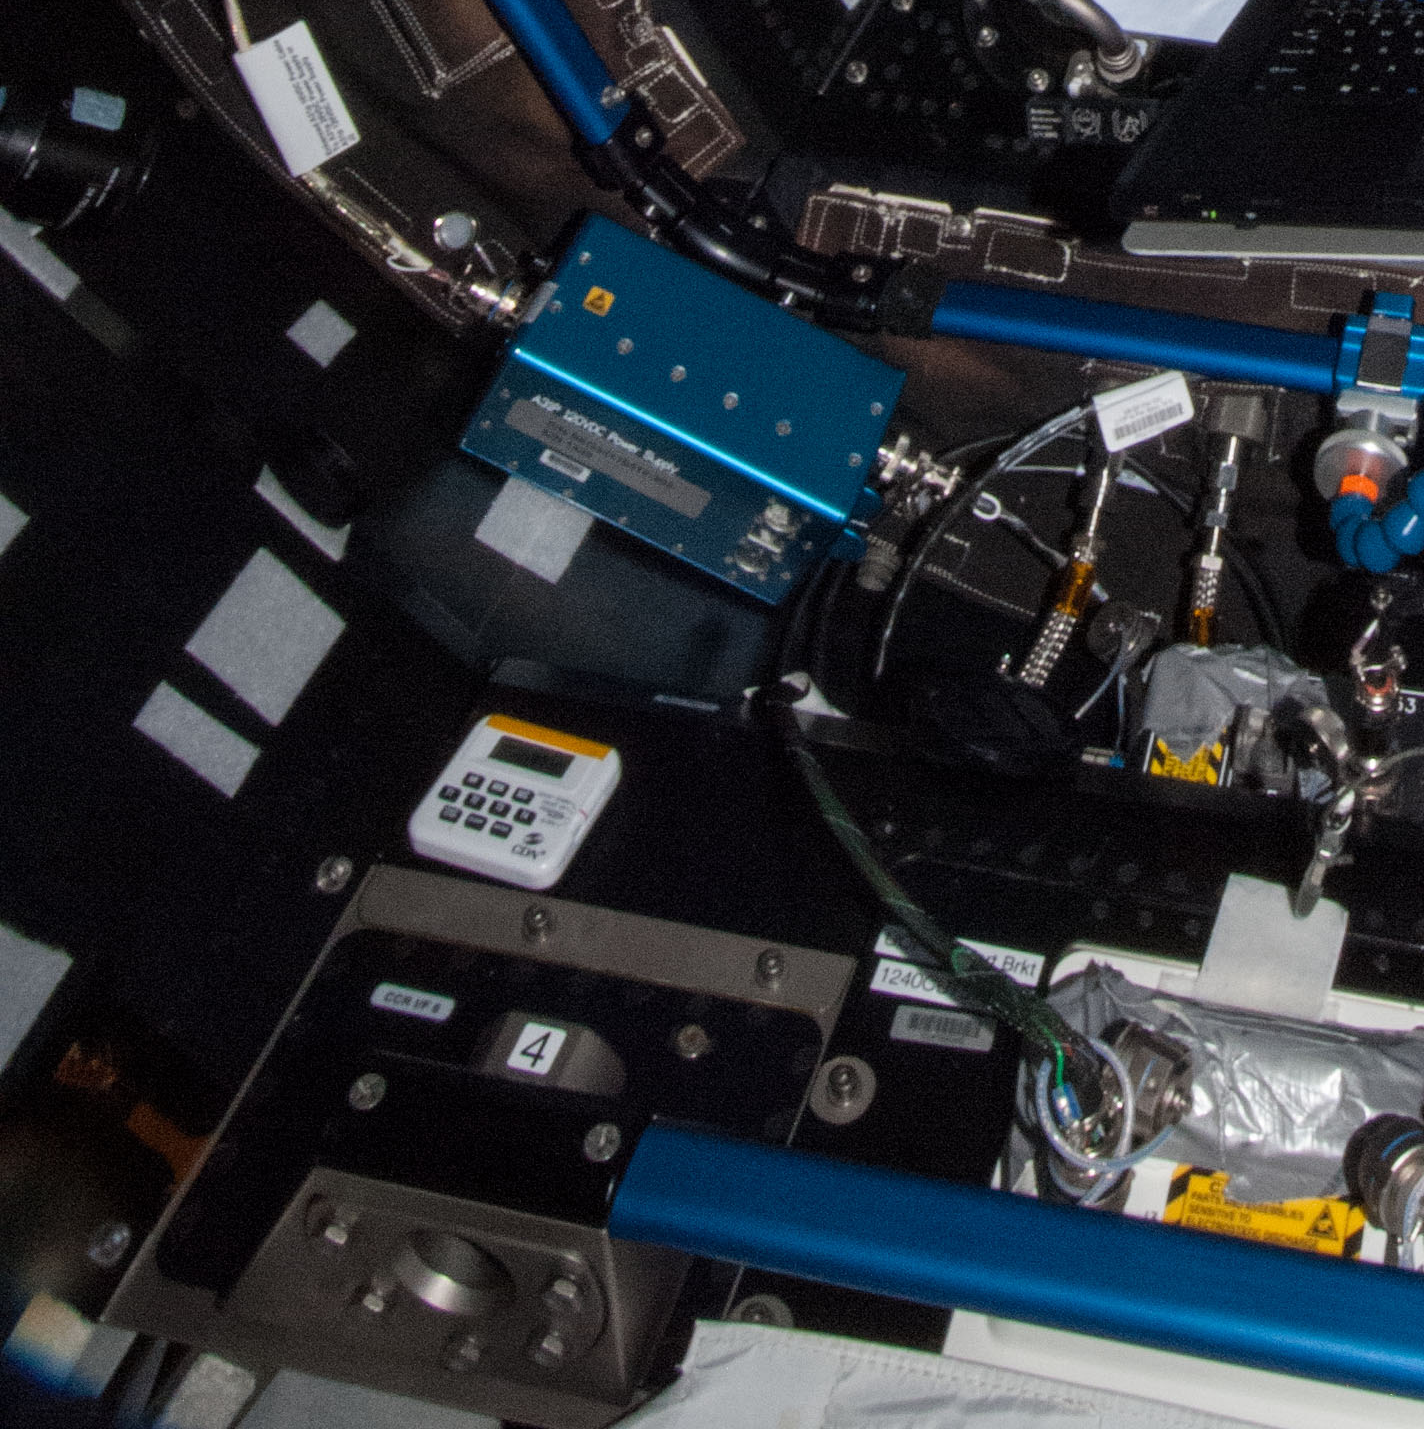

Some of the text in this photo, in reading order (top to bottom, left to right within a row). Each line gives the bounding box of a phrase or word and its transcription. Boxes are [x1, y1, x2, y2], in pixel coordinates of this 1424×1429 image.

[605, 430, 643, 456] Power
[640, 448, 682, 478] Supply
[1001, 955, 1038, 978] Brkt
[520, 1032, 550, 1067] 4
